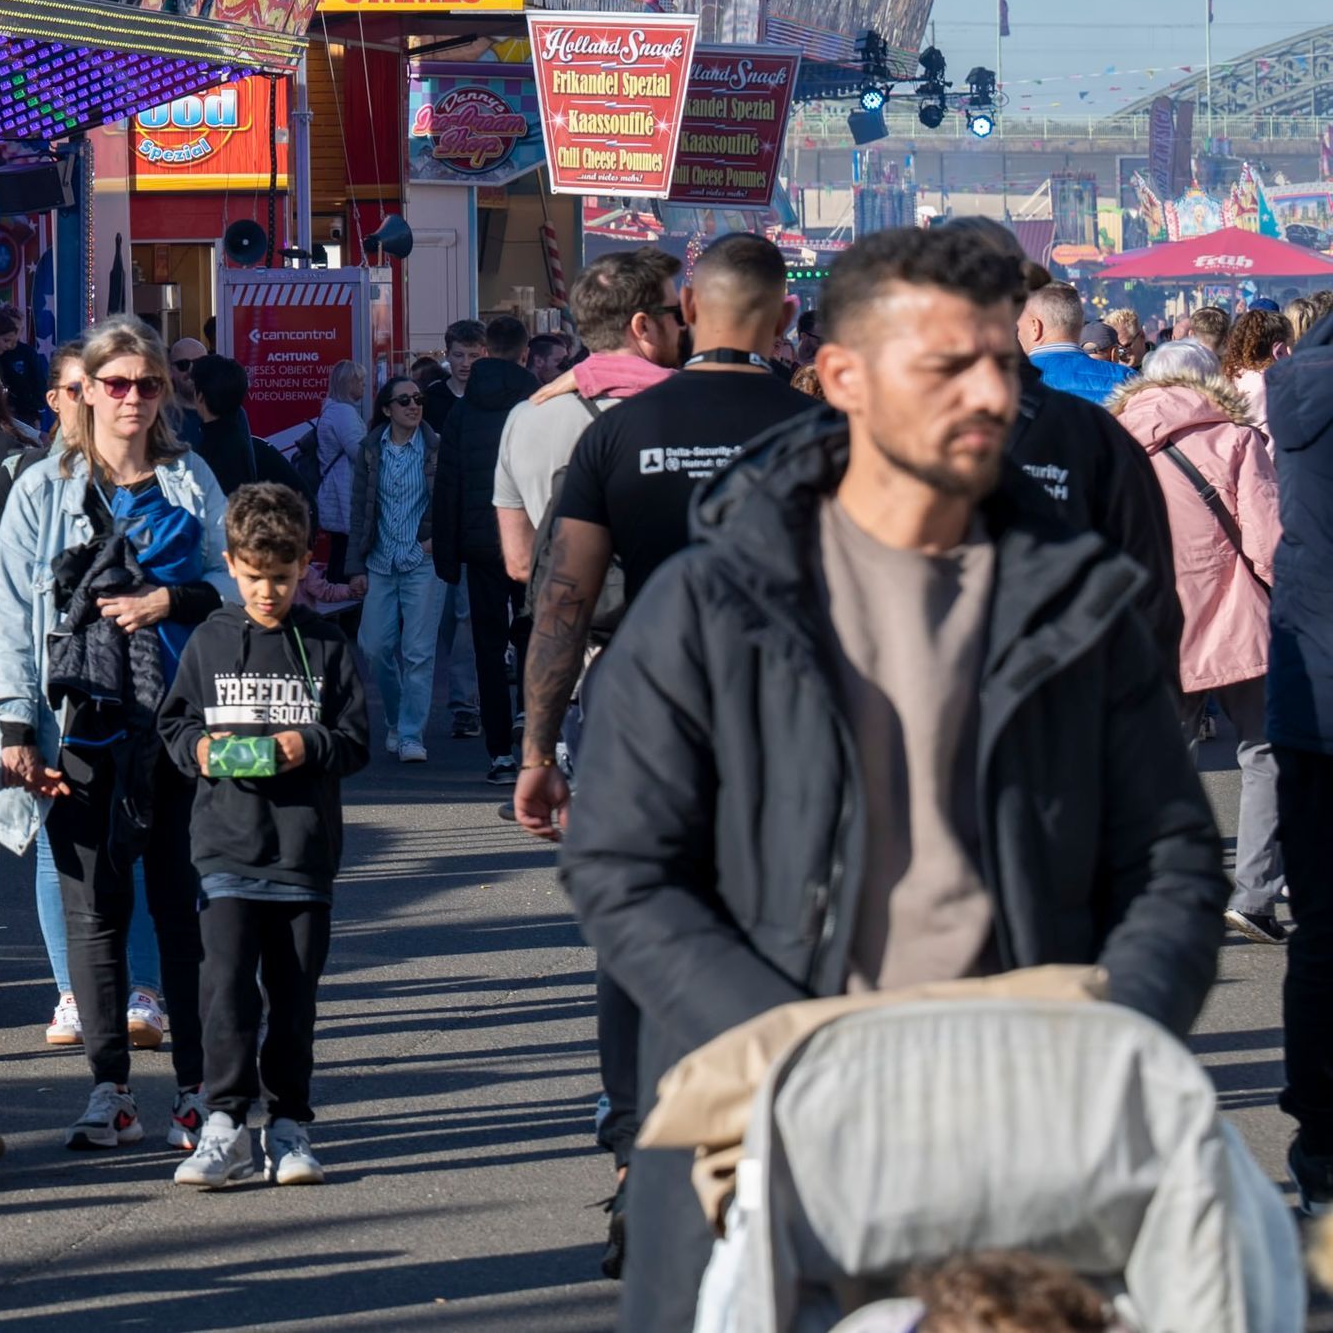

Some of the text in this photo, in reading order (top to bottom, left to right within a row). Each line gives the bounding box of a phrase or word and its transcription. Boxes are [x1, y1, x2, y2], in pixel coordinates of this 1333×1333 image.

[542, 28, 683, 64] Holland Snack
[553, 70, 671, 99] Frikandel Spezial
[689, 59, 788, 90] lland Snack
[138, 88, 238, 128] ood
[684, 97, 776, 121] kandel Spezial
[568, 109, 654, 136] Kaassoufflé
[138, 137, 212, 162] Spezial
[433, 126, 504, 168] Shop
[680, 131, 760, 155] Kaassoufflé
[557, 147, 662, 172] Chili Cheese Pommes
[620, 174, 644, 183] mehr!
[674, 165, 767, 188] hili Cheese Pommes
[262, 328, 337, 341] camcontrol
[267, 352, 319, 362] ACHTUNG
[279, 365, 314, 375] OBJEKT
[254, 377, 329, 388] STUNDEN ECHT
[248, 390, 328, 401] VIDEOÜBERWAC
[1022, 464, 1069, 484] curity
